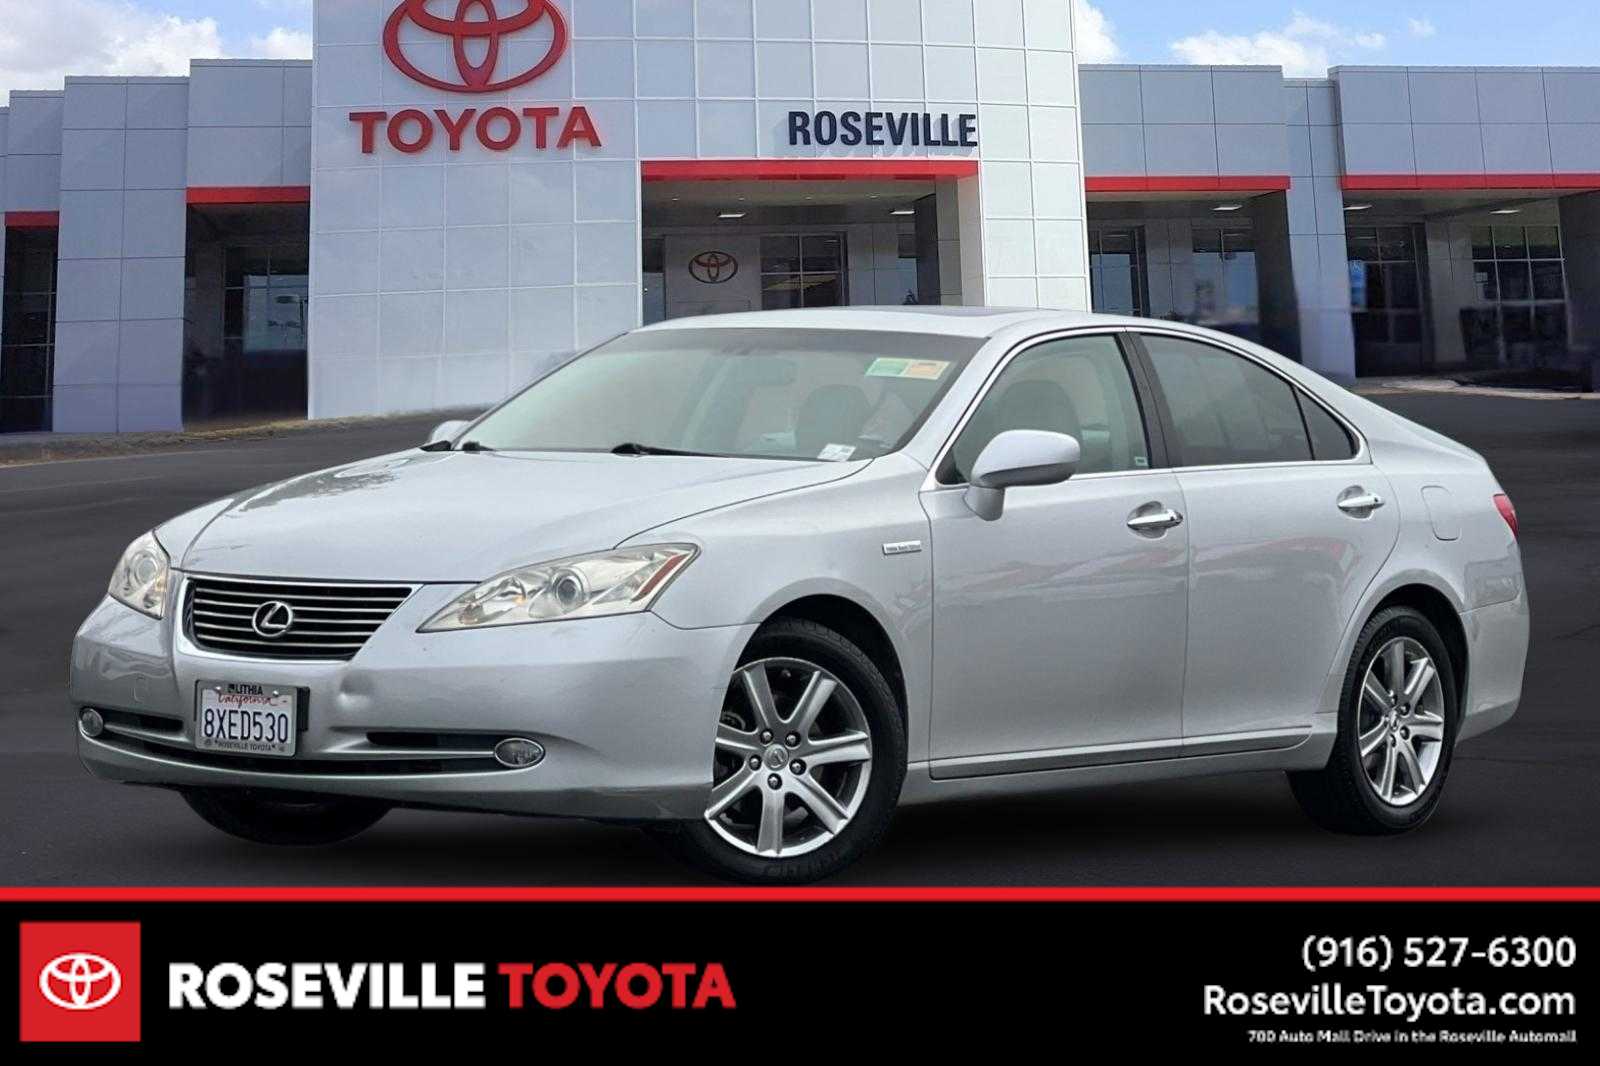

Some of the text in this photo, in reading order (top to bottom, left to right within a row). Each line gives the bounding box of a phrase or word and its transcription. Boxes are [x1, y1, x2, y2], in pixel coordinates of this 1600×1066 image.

[349, 105, 602, 154] TOYOTA
[788, 110, 978, 147] ROSEVILLE
[203, 708, 289, 743] 8XED530
